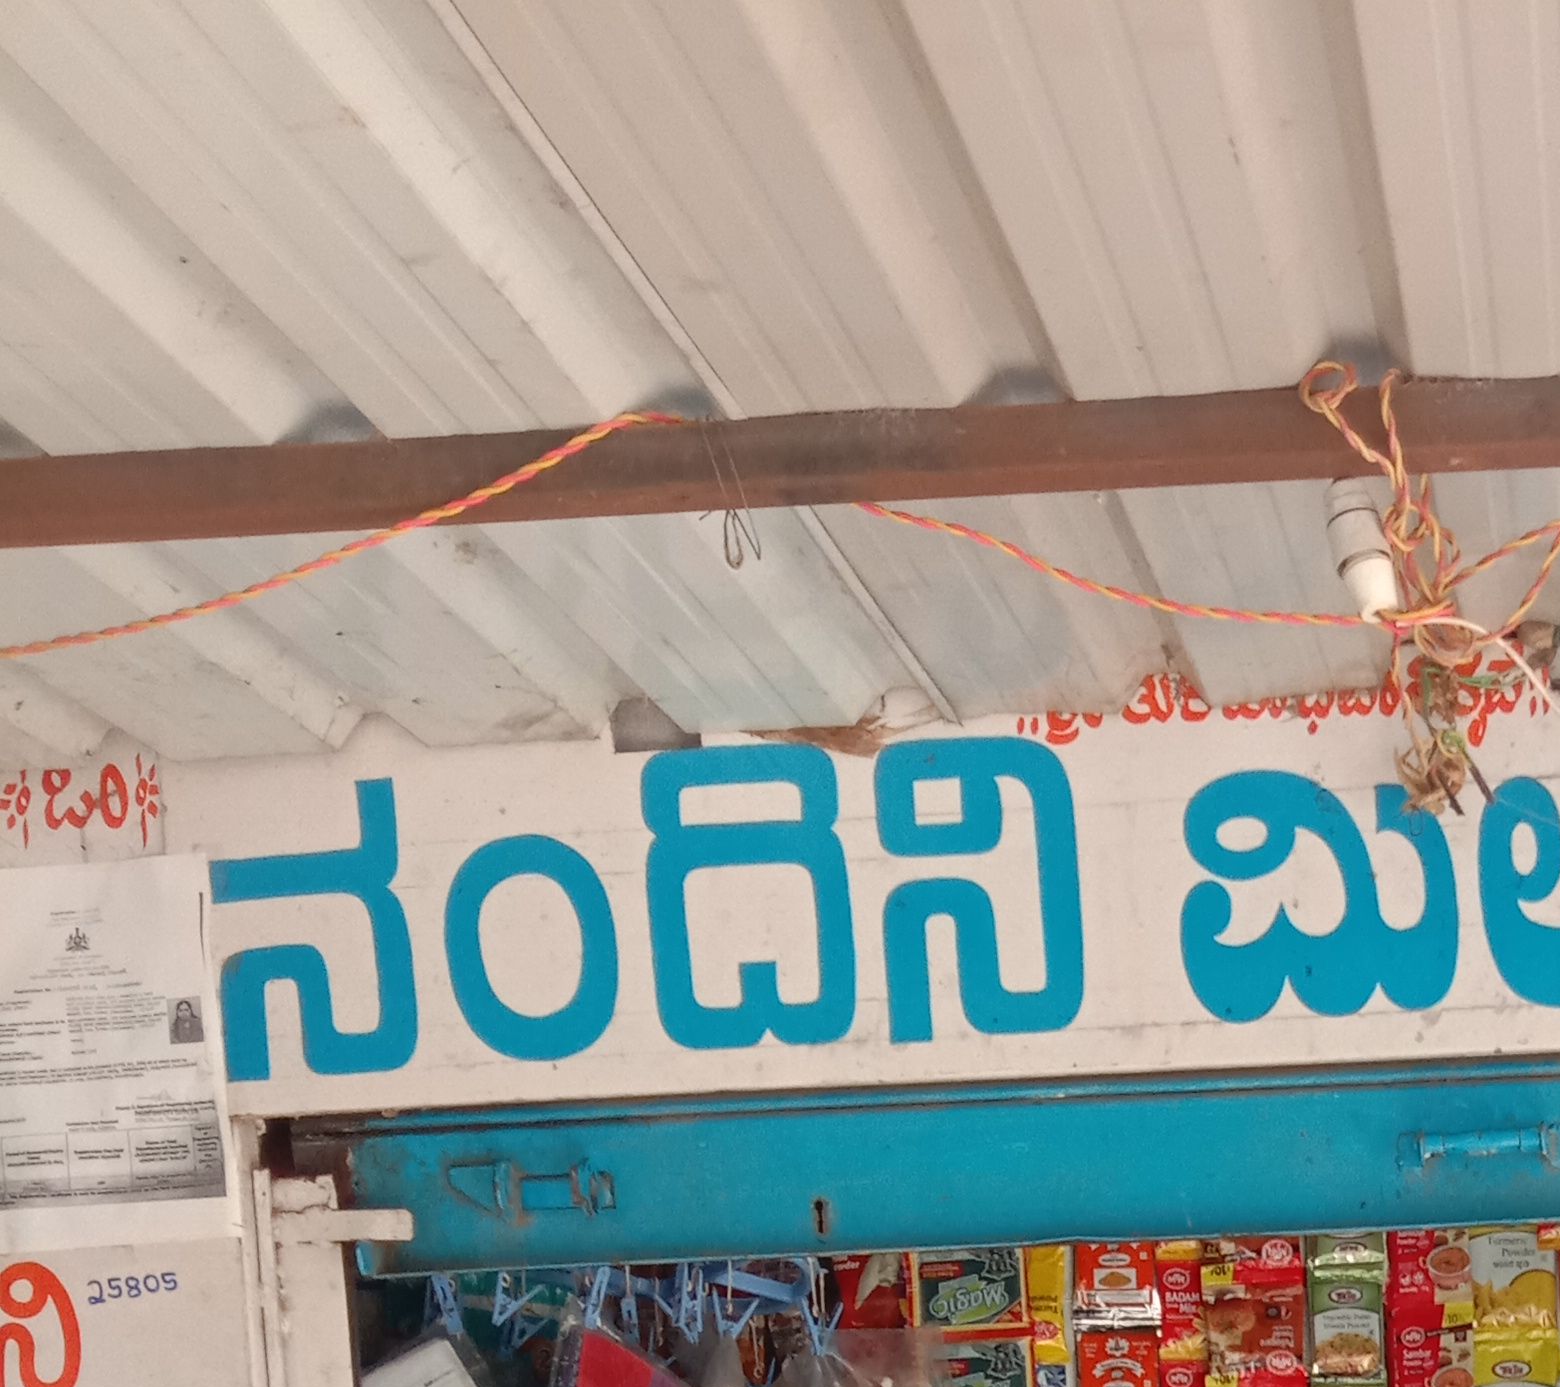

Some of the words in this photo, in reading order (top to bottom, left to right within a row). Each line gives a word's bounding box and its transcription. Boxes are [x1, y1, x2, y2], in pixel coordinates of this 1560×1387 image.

[210, 735, 1085, 1083] ನಂದಿನಿ
[87, 1272, 179, 1305] 25805
[1165, 1292, 1200, 1302] BADAM
